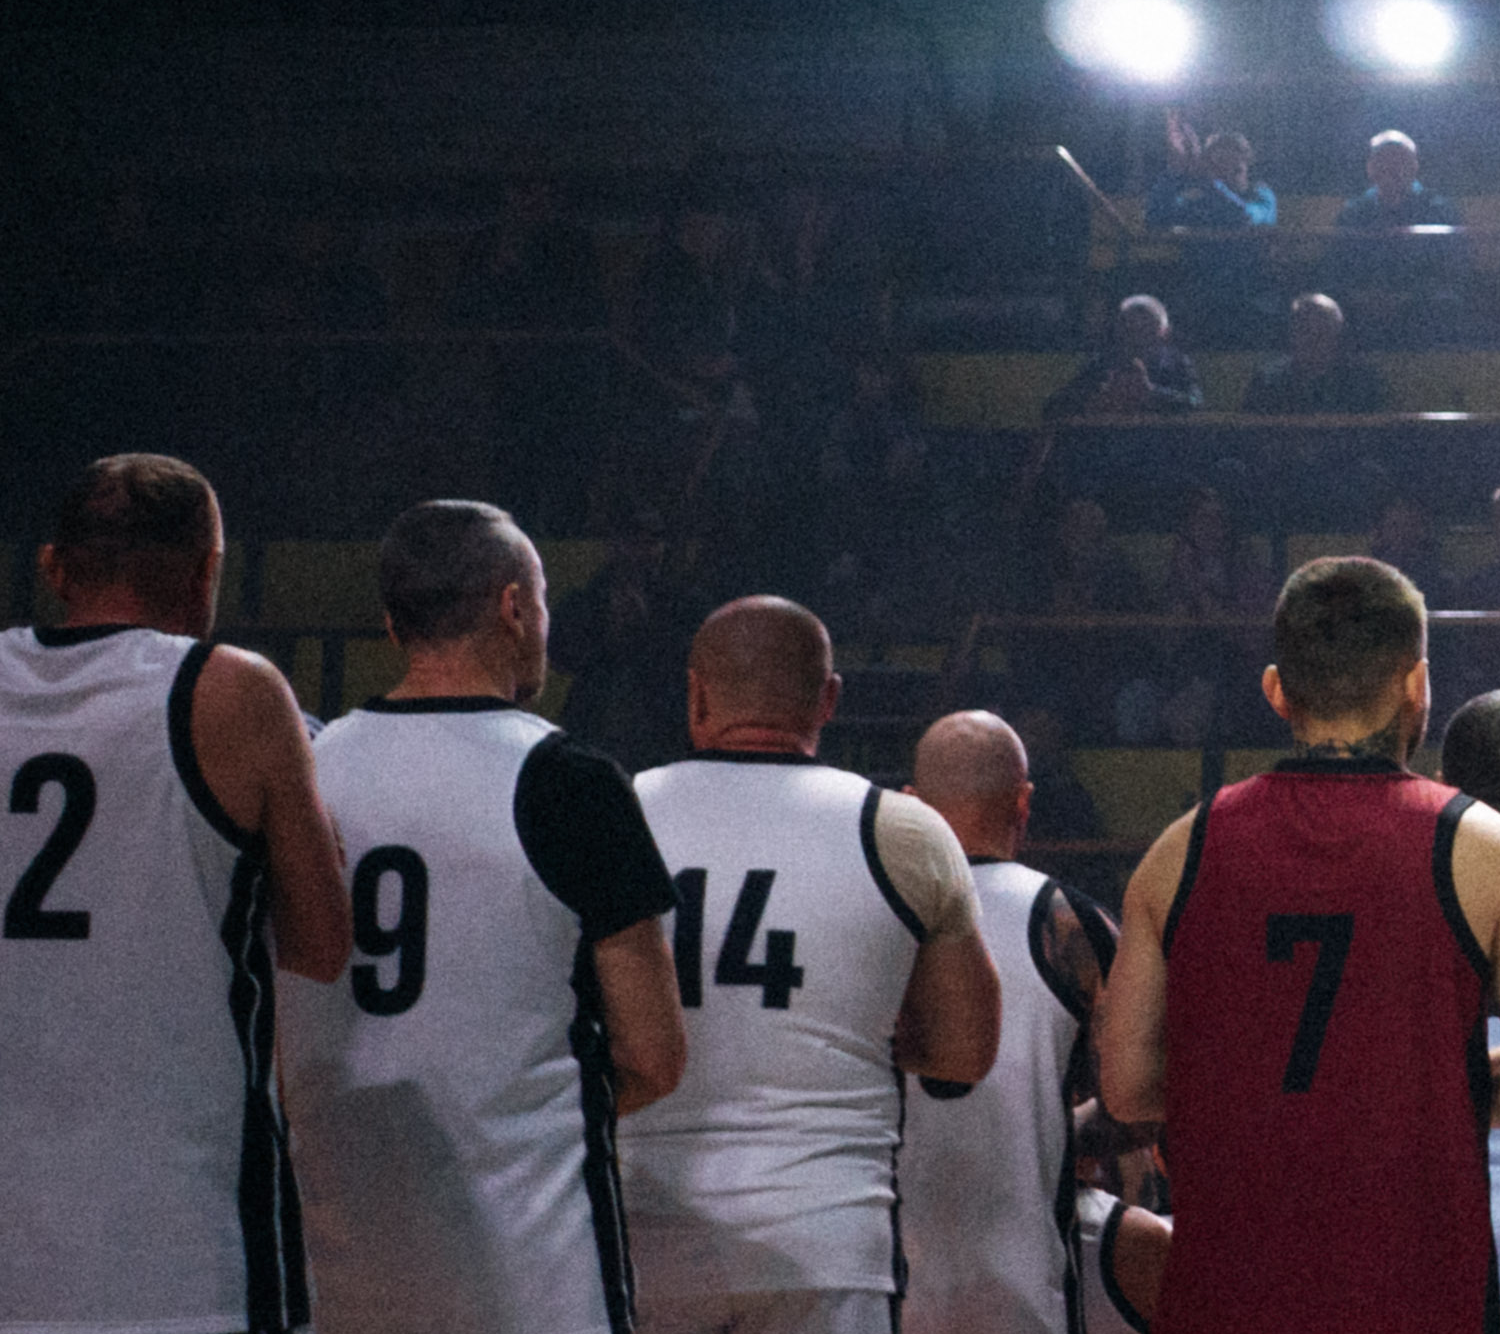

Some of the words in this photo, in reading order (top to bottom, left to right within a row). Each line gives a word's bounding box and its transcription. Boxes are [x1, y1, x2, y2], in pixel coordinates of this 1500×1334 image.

[3, 752, 97, 941] 2
[352, 845, 429, 1017] 9
[673, 866, 804, 1010] 14
[1265, 913, 1356, 1096] 7
